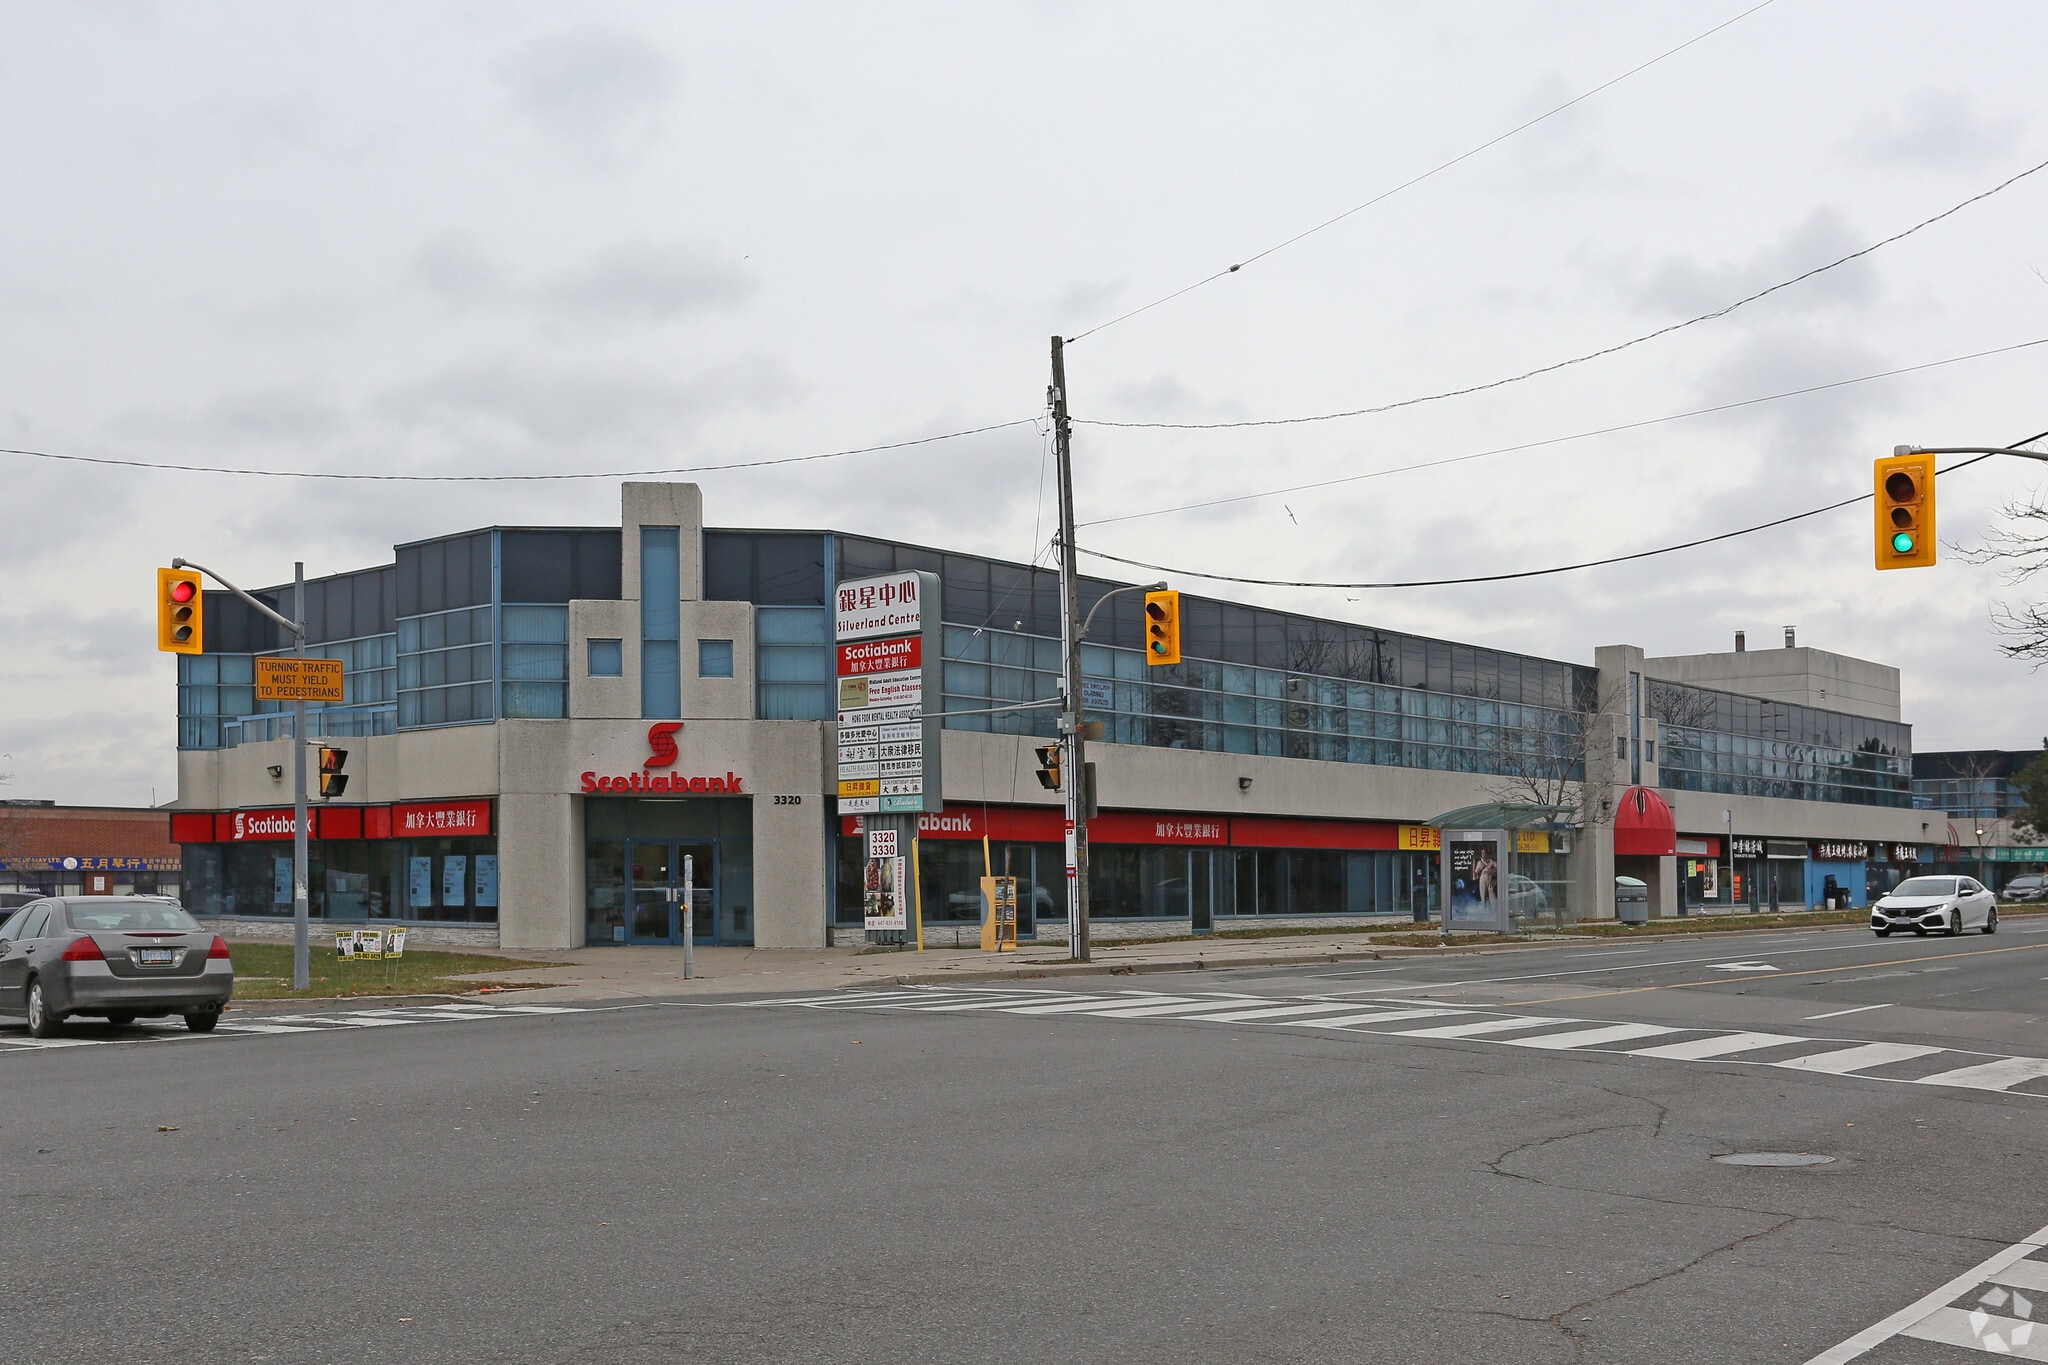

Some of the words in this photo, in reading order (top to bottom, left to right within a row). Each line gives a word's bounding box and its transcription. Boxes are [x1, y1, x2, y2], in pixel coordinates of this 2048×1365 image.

[839, 580, 916, 612] 銀星中心
[838, 615, 886, 632] Silverland
[889, 613, 920, 625] Centre
[845, 639, 912, 660] Scotiabank
[260, 661, 298, 672] TURNING
[302, 663, 340, 673] TRAFFIC
[272, 674, 297, 684] MUST
[302, 675, 328, 685] YIELD
[260, 686, 272, 696] TO
[277, 686, 340, 697] PEDESTRIANS
[869, 687, 880, 695] Free
[881, 685, 901, 695] English
[901, 683, 922, 692] Classes
[852, 714, 861, 724] HONG
[871, 712, 885, 722] MENTAL
[885, 711, 898, 720] HEALTH
[840, 765, 856, 773] HEALTH
[857, 764, 878, 772] BALANCE
[581, 770, 742, 794] Scotiabank
[774, 795, 801, 805] 3320
[248, 815, 312, 834] Scotiabak
[405, 810, 476, 829] 加拿大豐業銀行
[1155, 822, 1220, 838] 加拿大豐業銀行
[872, 832, 895, 843] 3320
[872, 844, 895, 855] 3330
[81, 857, 141, 869] 五月琴行
